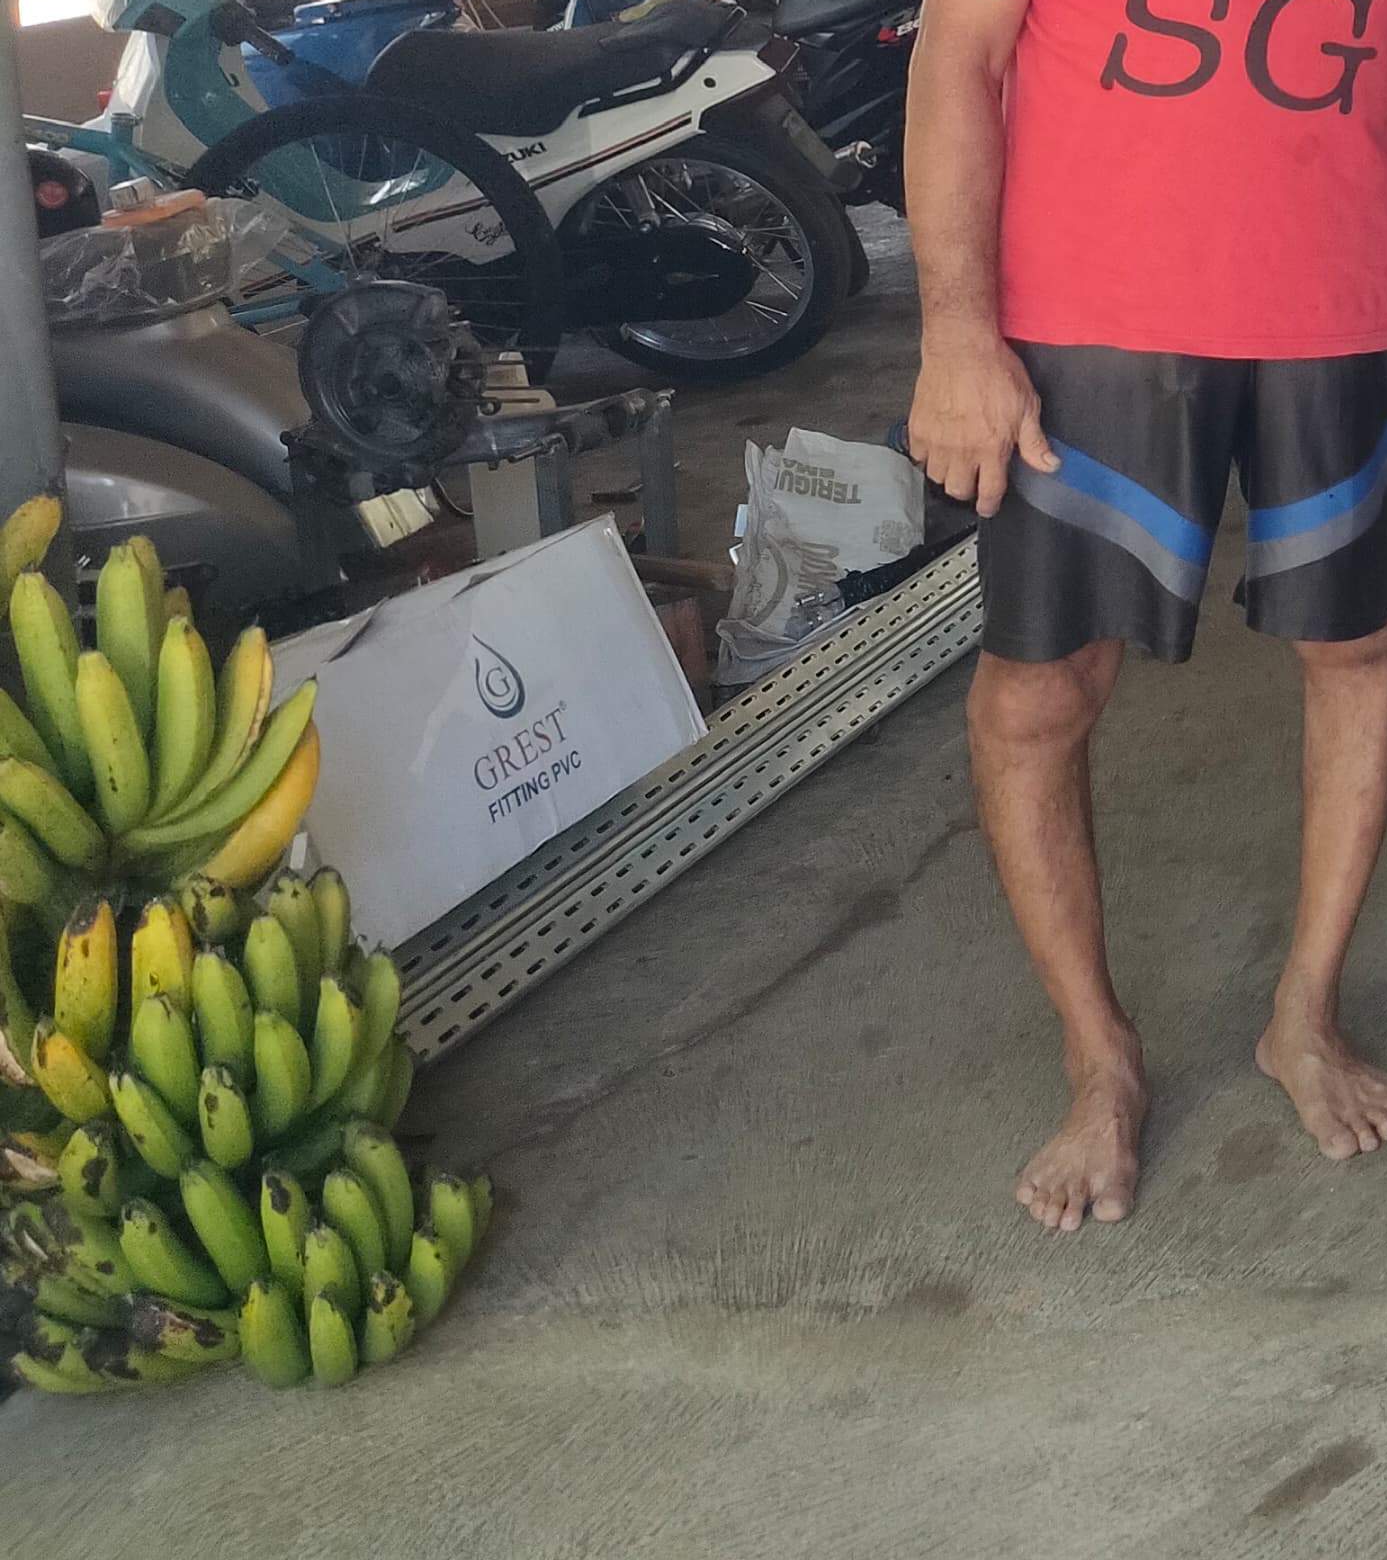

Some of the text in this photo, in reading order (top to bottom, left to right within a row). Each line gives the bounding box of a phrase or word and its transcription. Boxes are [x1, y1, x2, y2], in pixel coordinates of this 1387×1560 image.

[485, 666, 511, 698] G
[474, 707, 567, 790] GREST
[488, 750, 582, 824] FITTING PVC
